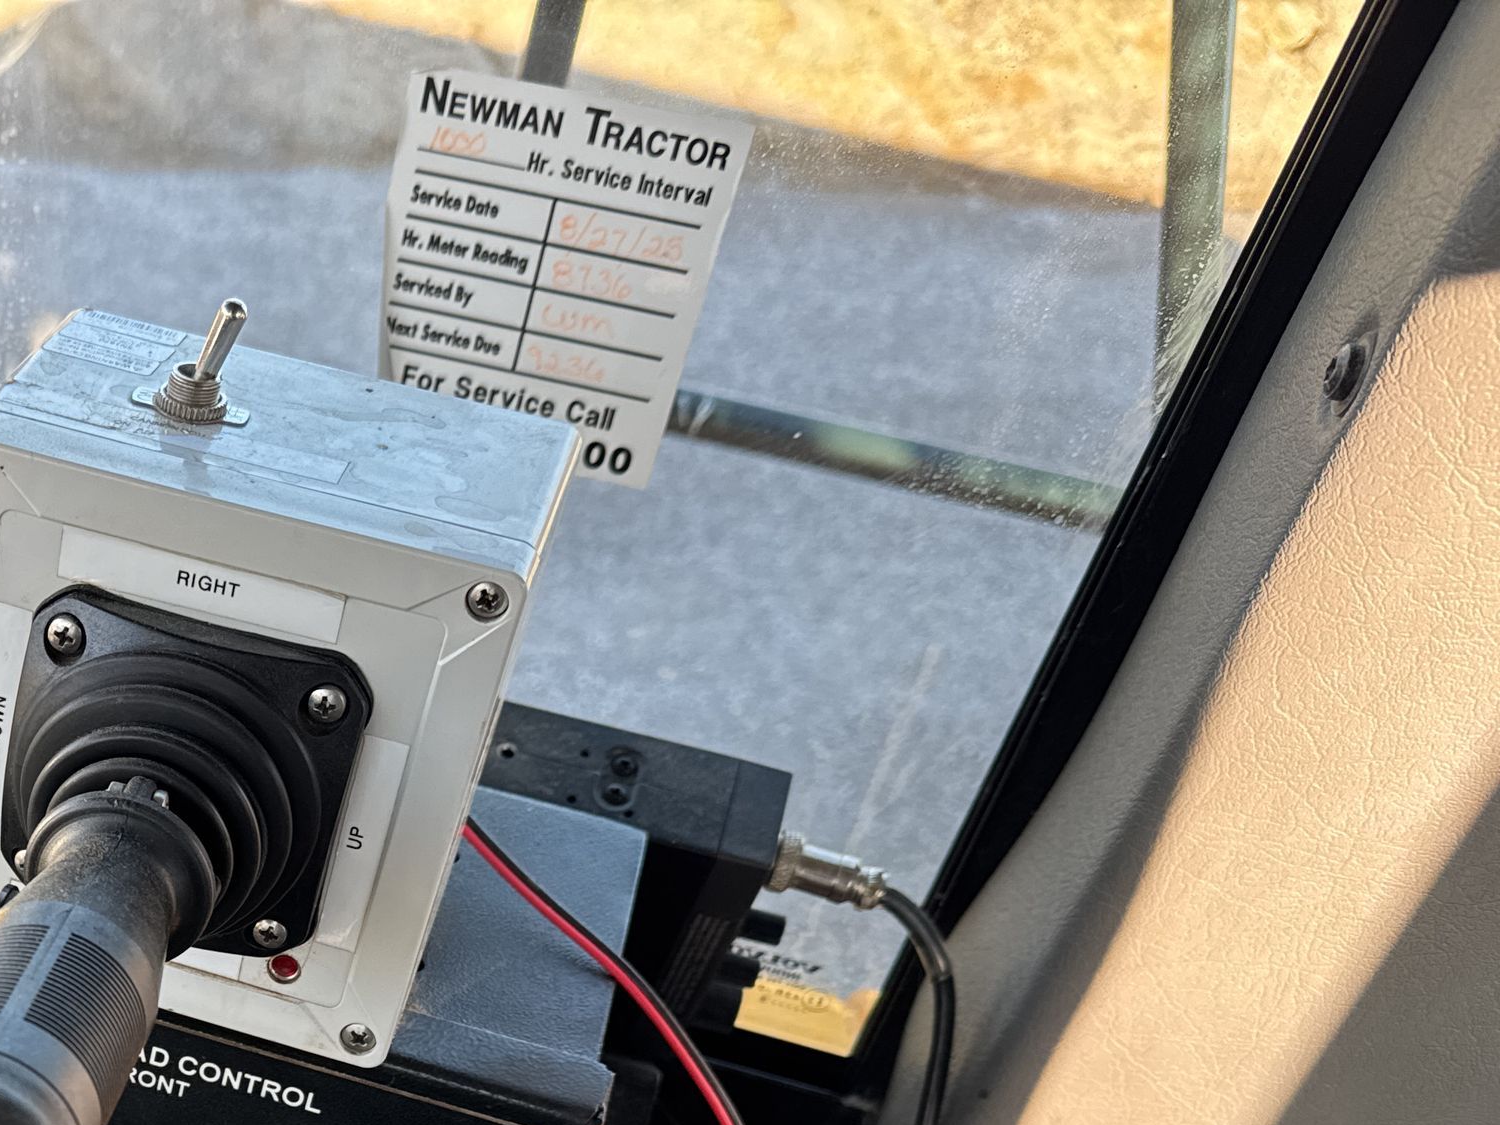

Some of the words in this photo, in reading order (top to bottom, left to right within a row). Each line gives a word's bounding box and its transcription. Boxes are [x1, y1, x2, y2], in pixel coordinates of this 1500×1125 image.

[420, 76, 565, 138] NEWMAN
[585, 106, 731, 171] TRACTOR
[526, 151, 553, 176] Hr.
[561, 158, 632, 191] Service
[636, 173, 713, 207] Interval
[410, 184, 462, 211] Service
[465, 195, 499, 219] Date
[402, 228, 423, 250] Hr.
[426, 234, 469, 259] Meter
[472, 243, 529, 275] Reading
[393, 273, 454, 301] Serviced
[455, 285, 473, 309] By
[387, 316, 418, 334] Next
[423, 324, 470, 349] Service
[473, 336, 501, 356] Due
[401, 364, 445, 392] For
[454, 376, 554, 418] Service
[565, 400, 617, 431] Call
[176, 569, 241, 598] RIGHT
[346, 826, 364, 850] UP
[178, 1055, 322, 1115] CONTROL
